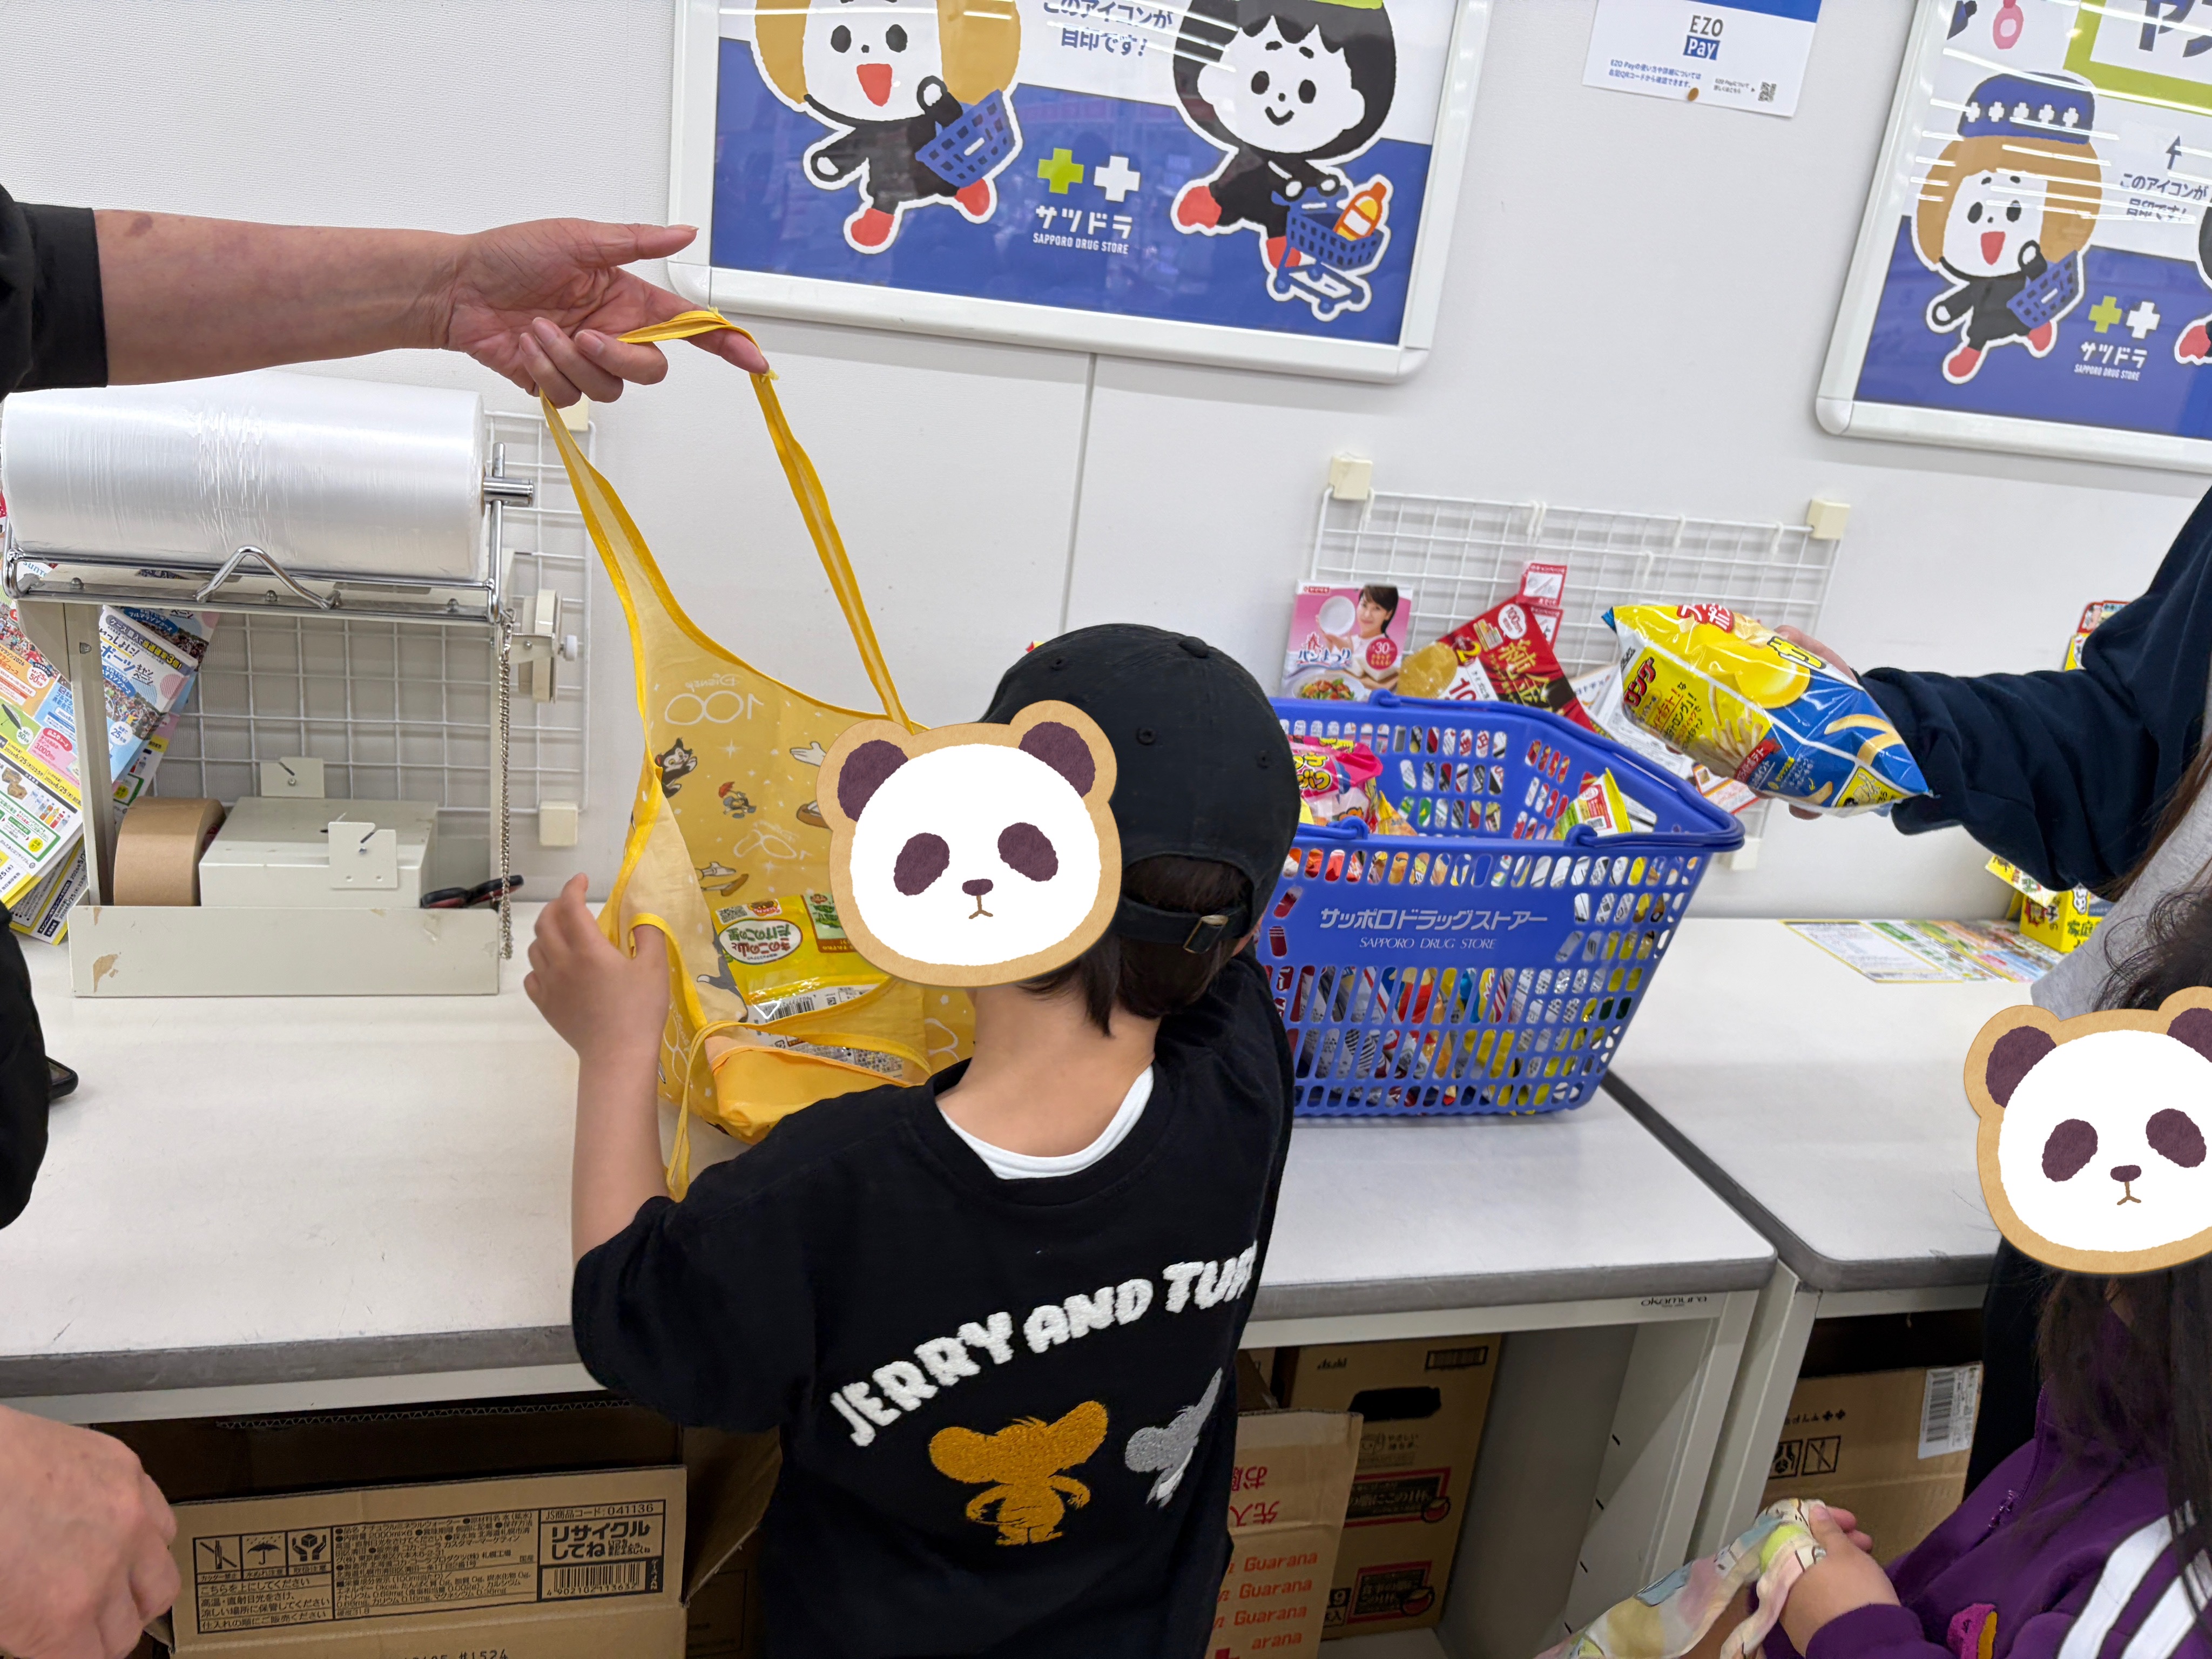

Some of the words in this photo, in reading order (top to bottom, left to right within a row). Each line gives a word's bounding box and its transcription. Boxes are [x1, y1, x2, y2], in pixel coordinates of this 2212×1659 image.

[1689, 15, 1724, 37] EZO
[1687, 38, 1717, 59] Pay
[2120, 173, 2209, 200] このアイコンが
[1035, 205, 1133, 239] サツドラ
[1033, 232, 1073, 247] SAPPORO
[1075, 238, 1100, 251] DRUG
[1101, 241, 1130, 255] STORE
[2081, 341, 2148, 369] サツドラ
[2074, 363, 2102, 376] SAPPORO
[2120, 370, 2141, 381] STORE
[1319, 907, 1548, 931] サッポロドラッグストアー
[726, 923, 791, 941] たけのこの里
[1359, 936, 1415, 949] SAPPORO
[1419, 938, 1456, 949] DRUG
[1460, 939, 1497, 949] STORE
[1641, 1296, 1707, 1306] okamura
[830, 1311, 1015, 1447] JERRY
[1023, 1278, 1154, 1354] AND
[552, 1520, 651, 1543] リサイクル
[552, 1541, 605, 1560] してね
[1244, 1552, 1318, 1572] Guarana
[200, 1578, 310, 1595] こちらを上にしてください
[1238, 1579, 1313, 1599] Guarana
[1233, 1606, 1307, 1626] Guarana
